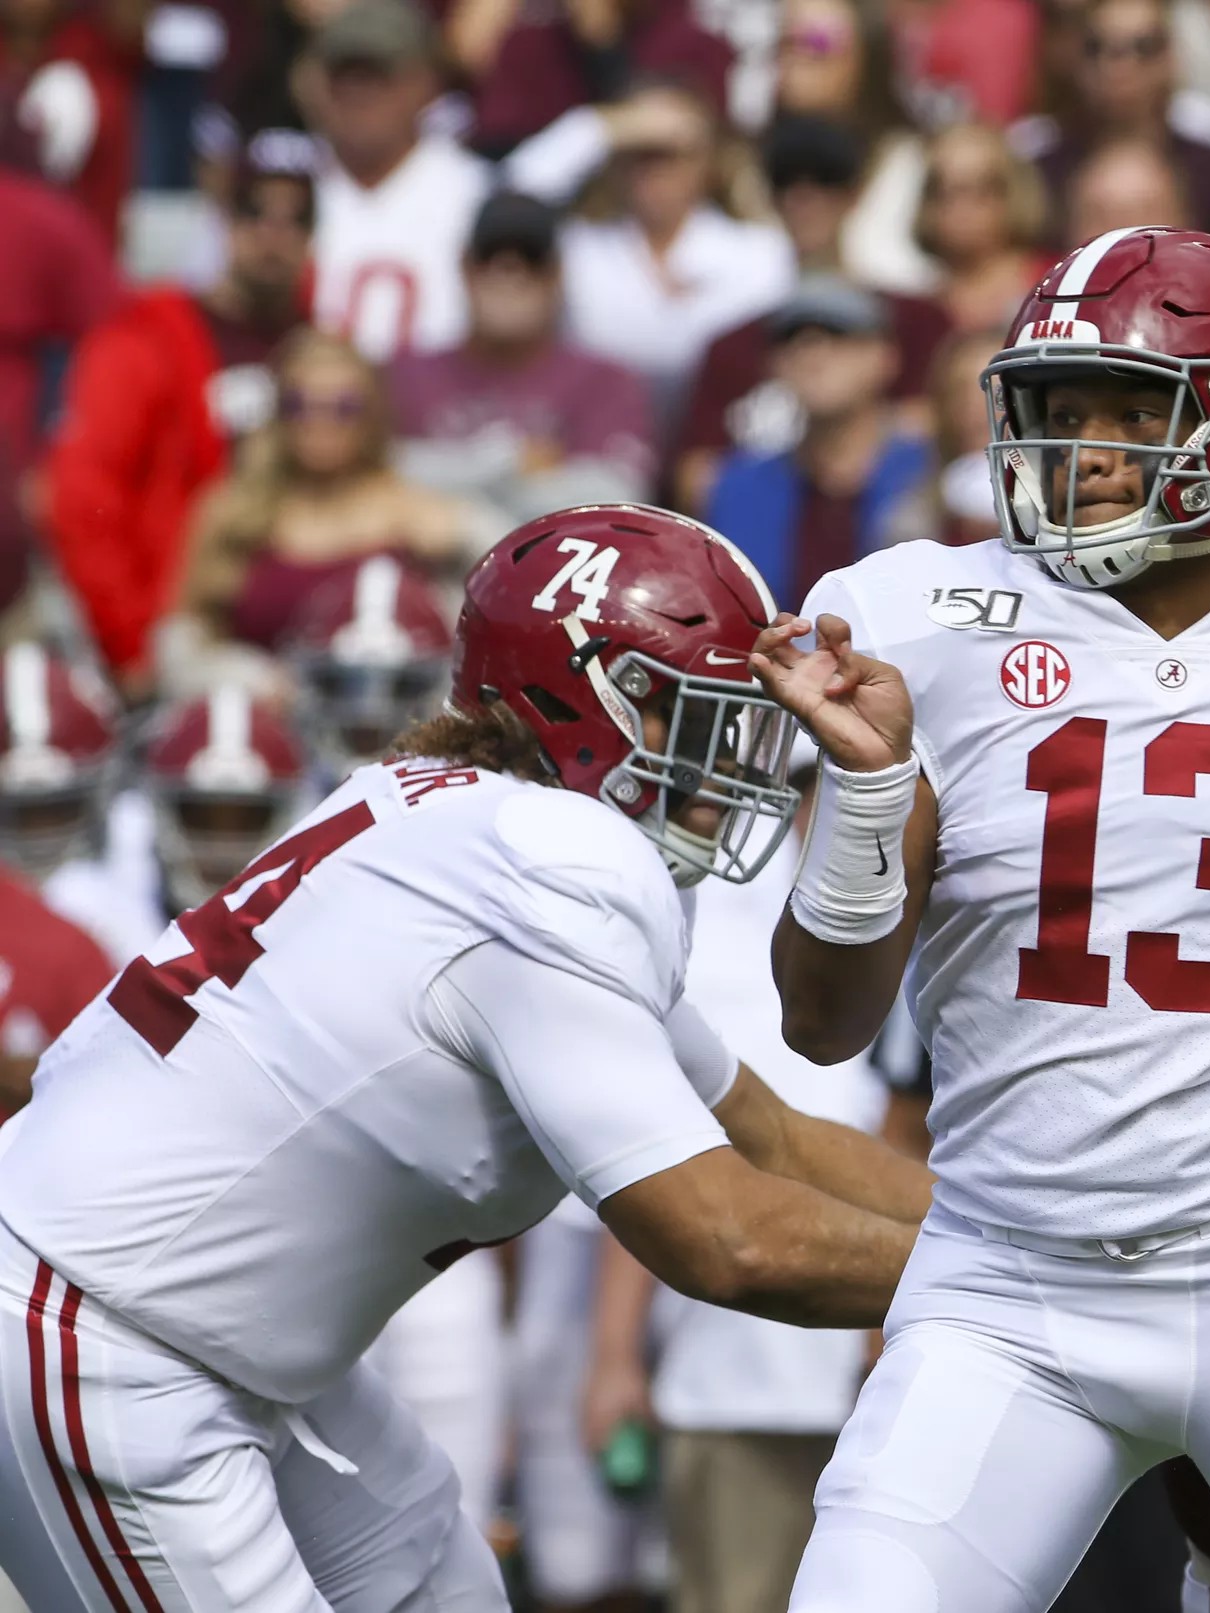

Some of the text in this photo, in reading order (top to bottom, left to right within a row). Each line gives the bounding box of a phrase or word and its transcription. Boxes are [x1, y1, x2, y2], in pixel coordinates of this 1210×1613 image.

[1031, 321, 1074, 339] BAMA
[532, 537, 621, 622] 74
[931, 588, 1023, 628] 150
[1005, 643, 1067, 706] SEC
